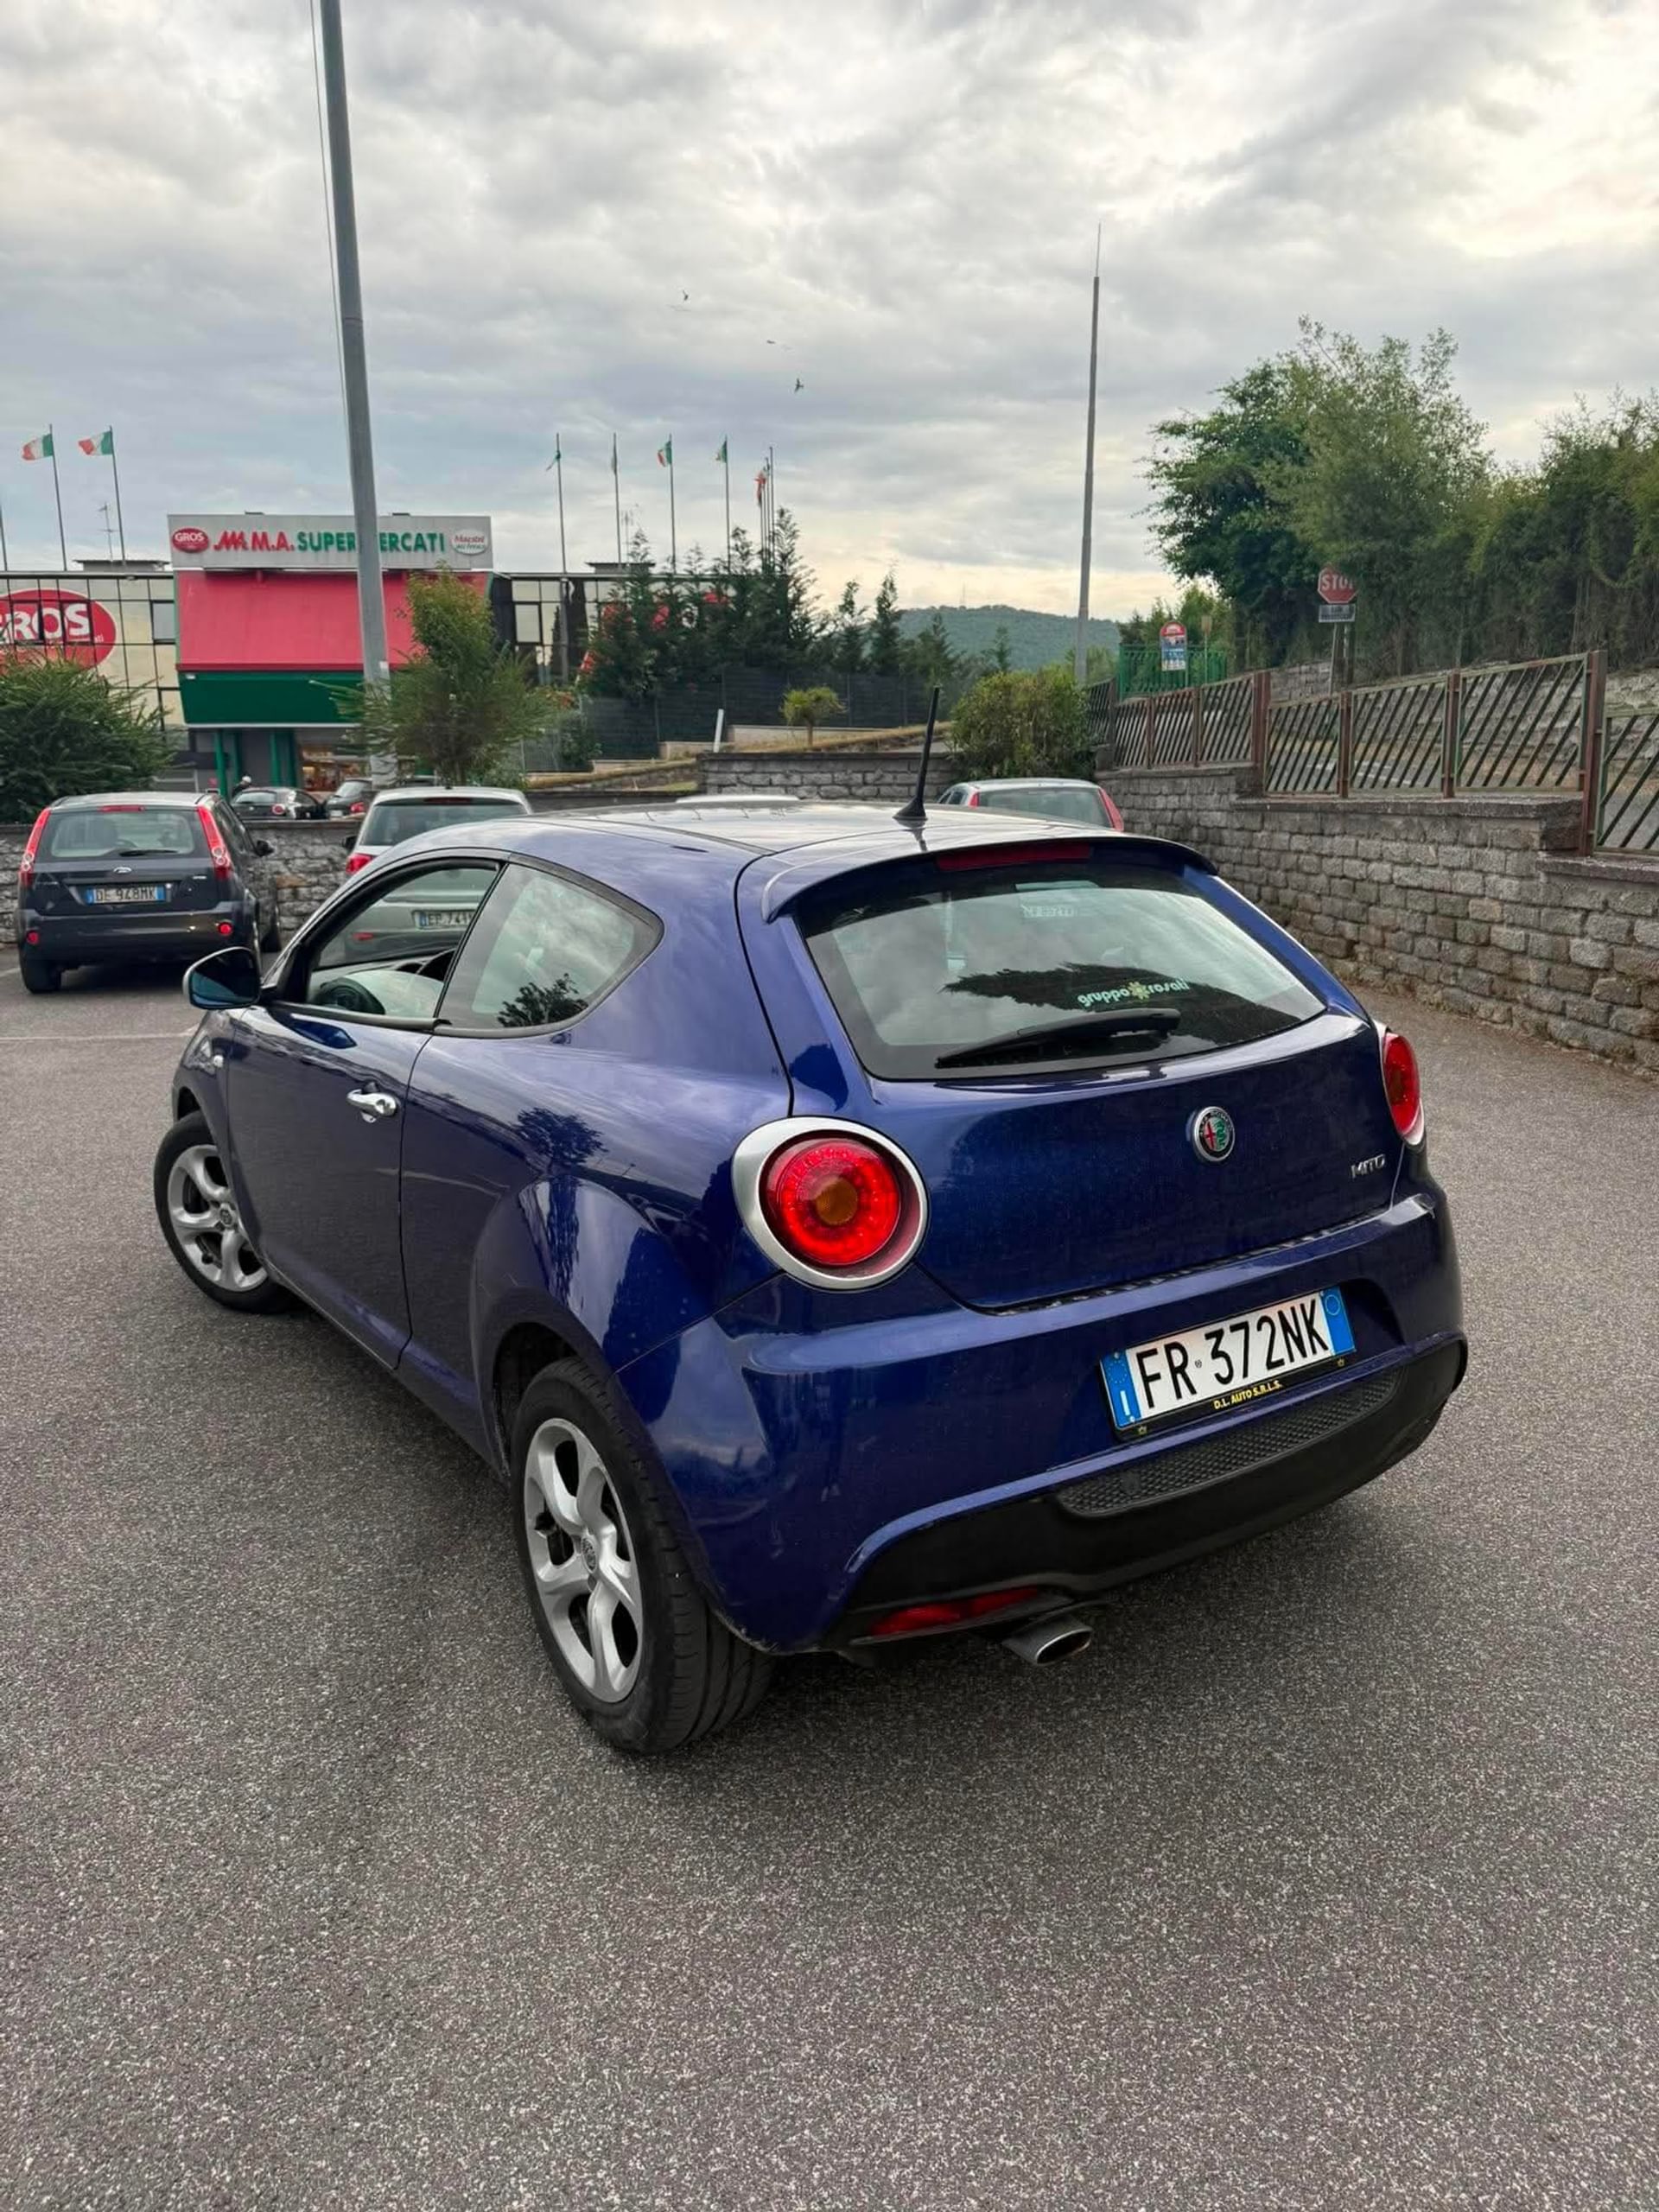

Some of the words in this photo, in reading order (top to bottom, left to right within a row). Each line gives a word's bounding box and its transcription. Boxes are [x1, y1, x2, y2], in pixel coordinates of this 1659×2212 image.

[175, 531, 205, 543] GROS
[297, 531, 445, 551] SUPERERCATI
[0, 603, 91, 644] ROS
[1077, 988, 1130, 1007] gruppo
[1147, 977, 1191, 994] rosati
[1351, 1154, 1385, 1179] MITO
[1135, 1341, 1198, 1408] FR
[1205, 1299, 1329, 1385] 372NK
[1231, 1389, 1253, 1404] AUTO
